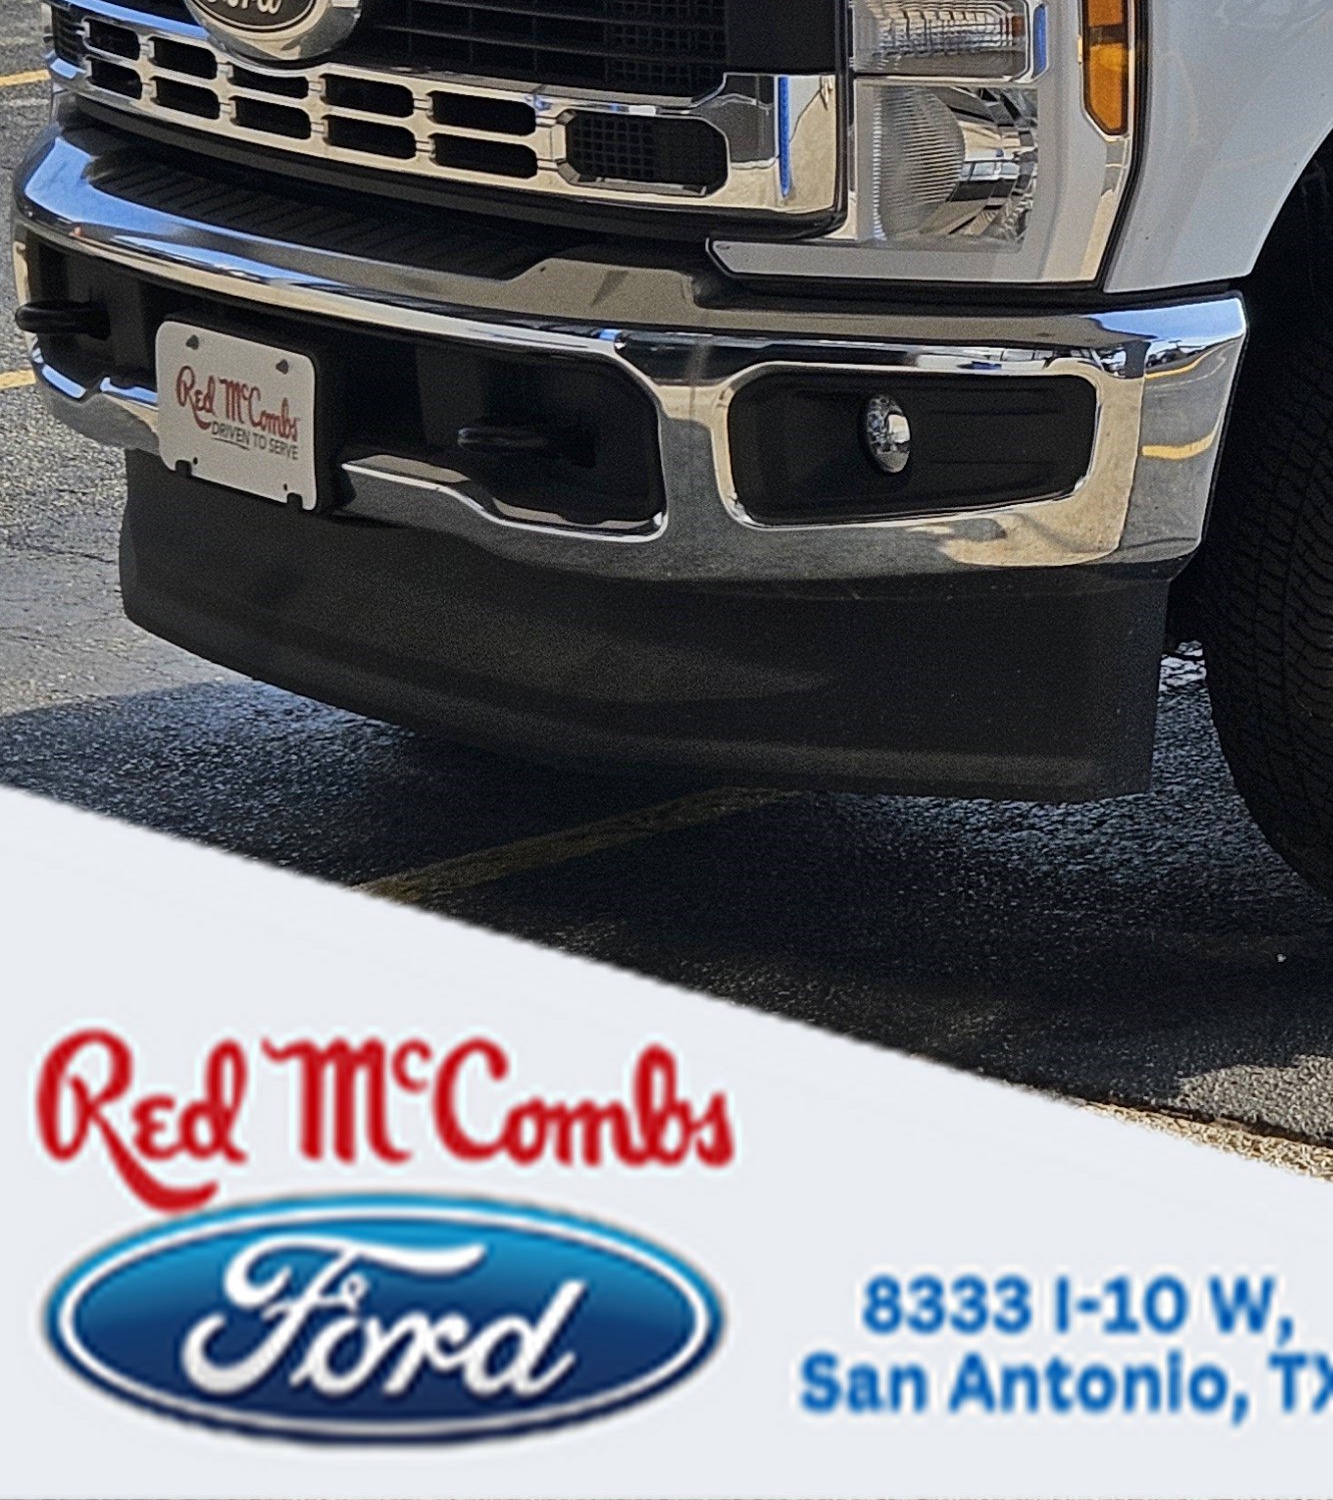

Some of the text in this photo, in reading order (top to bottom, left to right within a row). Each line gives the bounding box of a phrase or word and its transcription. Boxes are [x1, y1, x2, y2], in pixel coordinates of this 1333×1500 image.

[175, 365, 301, 443] Red McCombs
[210, 421, 300, 461] DRIVEN TO SERVE
